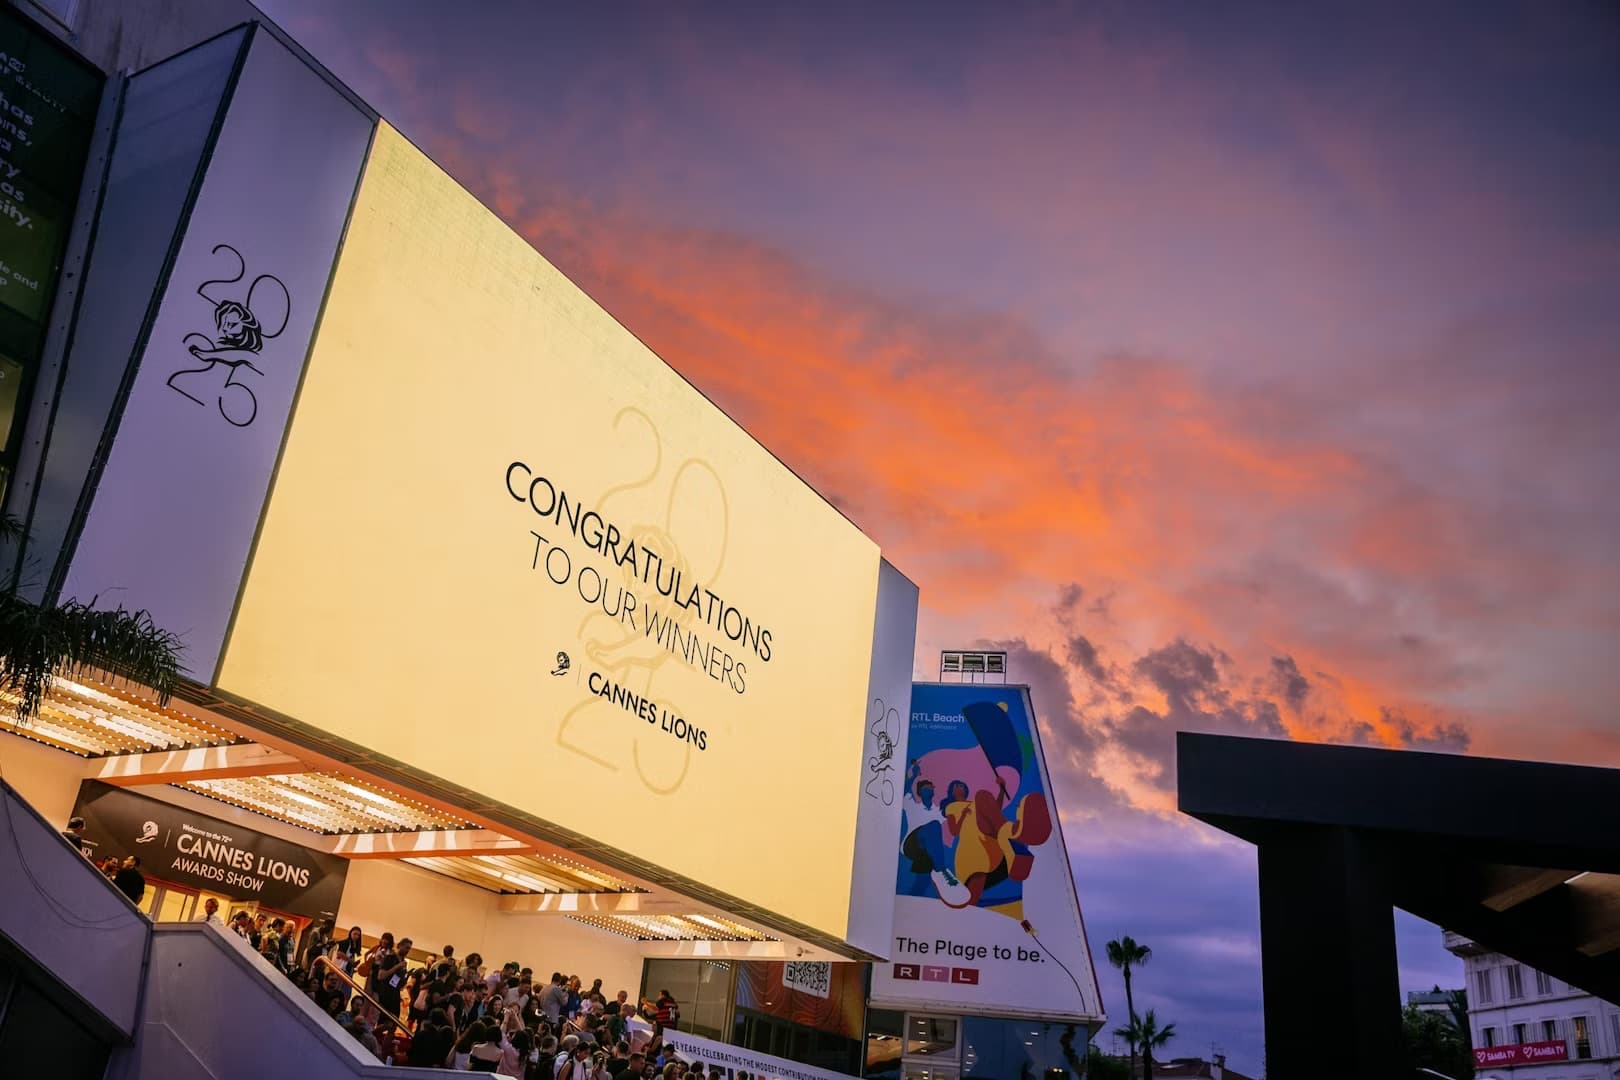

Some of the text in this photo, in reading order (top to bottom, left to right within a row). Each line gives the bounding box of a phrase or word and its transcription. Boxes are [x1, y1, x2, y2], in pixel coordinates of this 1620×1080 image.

[505, 461, 772, 662] CONGRATULATIONS
[530, 530, 747, 695] TO OUR WINNERS
[588, 672, 707, 750] CANNES LIONS
[911, 712, 965, 724] RTL Beach
[182, 823, 206, 837] Welcome
[212, 833, 221, 841] the
[171, 857, 264, 892] AWARDS SHOW
[176, 834, 310, 888] CANNES LIONS
[896, 937, 1045, 963] The Plage to be.
[680, 1043, 701, 1056] YEARS
[702, 1048, 743, 1066] CELEBRATING
[743, 1058, 755, 1069] THE
[755, 1061, 778, 1074] MODEST
[1486, 1050, 1516, 1061] SAMBA TV
[1533, 1045, 1565, 1057] SAMBA TV
